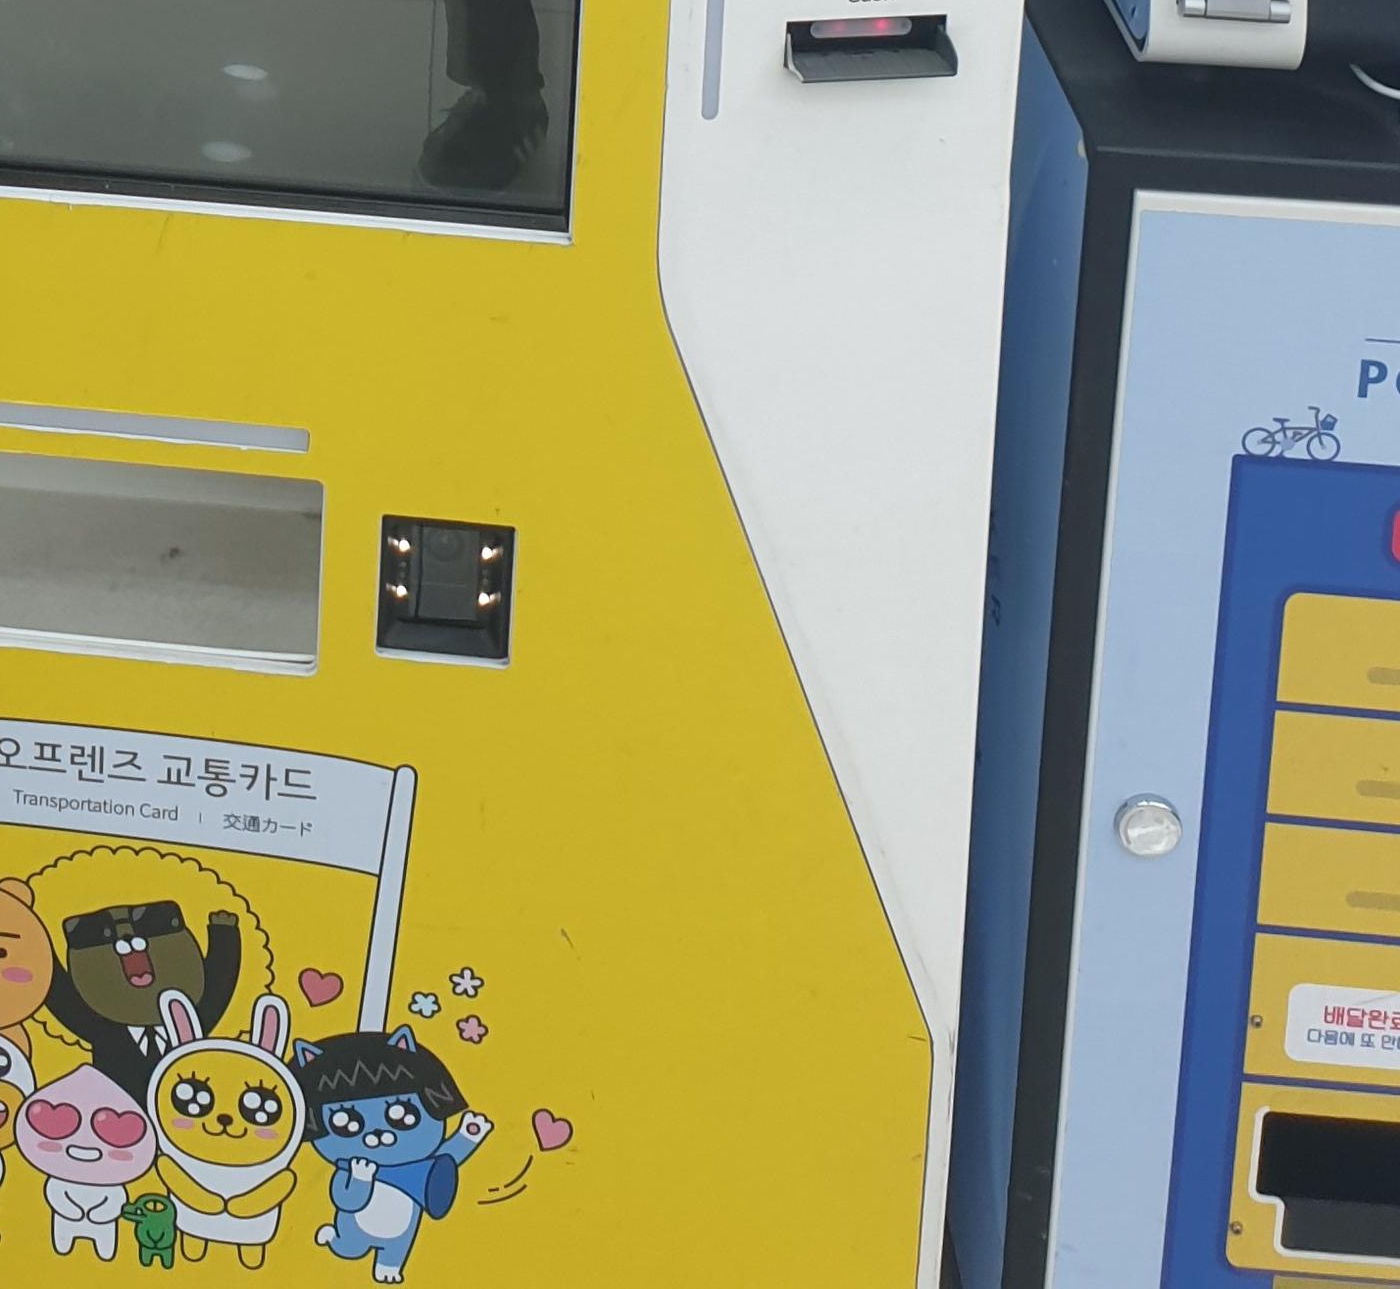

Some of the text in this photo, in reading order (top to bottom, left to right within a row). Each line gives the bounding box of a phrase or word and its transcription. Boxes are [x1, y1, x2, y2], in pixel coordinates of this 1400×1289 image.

[156, 752, 318, 802] 교통카드
[13, 788, 179, 821] Transportation Card
[223, 813, 313, 837] 交通カード
[1306, 1028, 1400, 1050] 다음에 또 만
